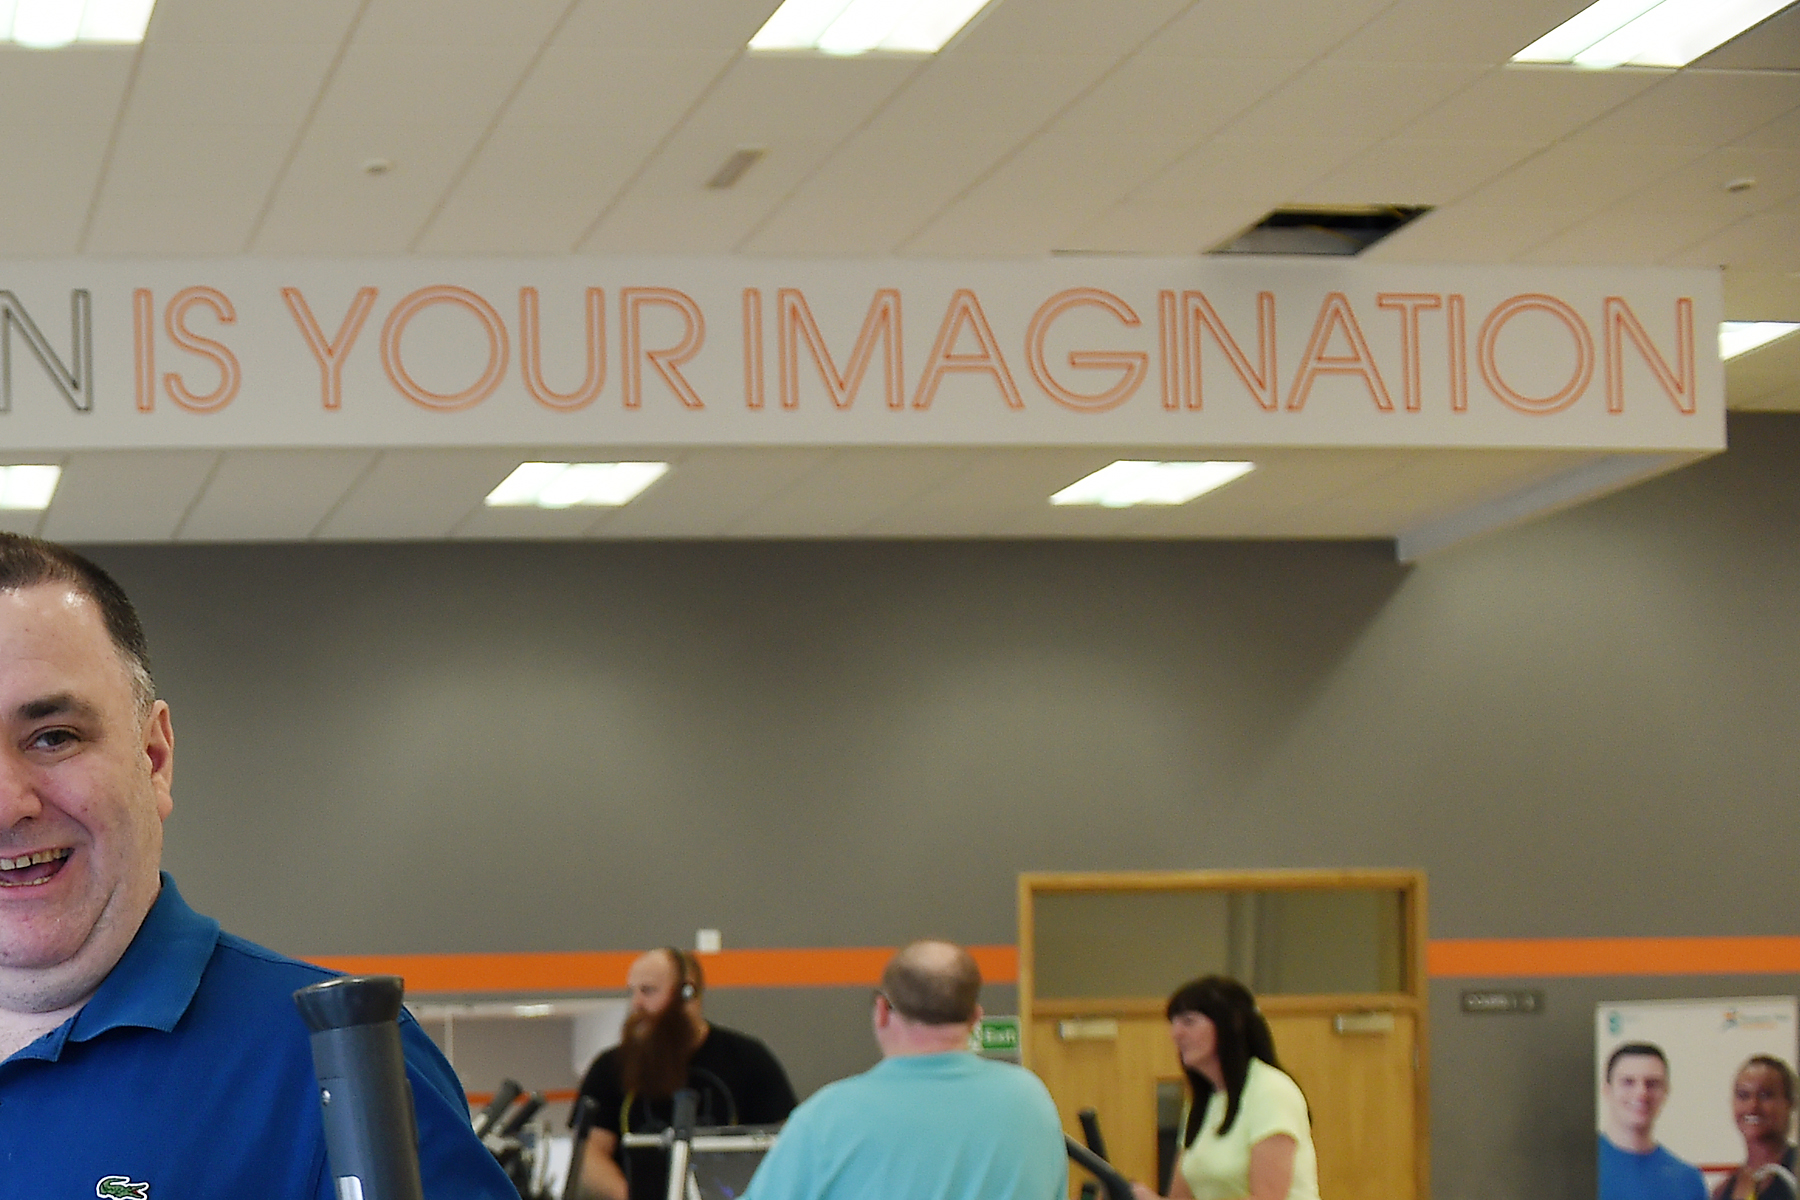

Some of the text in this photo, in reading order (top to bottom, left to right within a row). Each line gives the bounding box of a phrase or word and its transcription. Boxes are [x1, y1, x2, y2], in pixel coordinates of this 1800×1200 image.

[132, 285, 242, 414] IS
[280, 284, 706, 413] YOUR
[742, 286, 1697, 415] IMAGINATION
